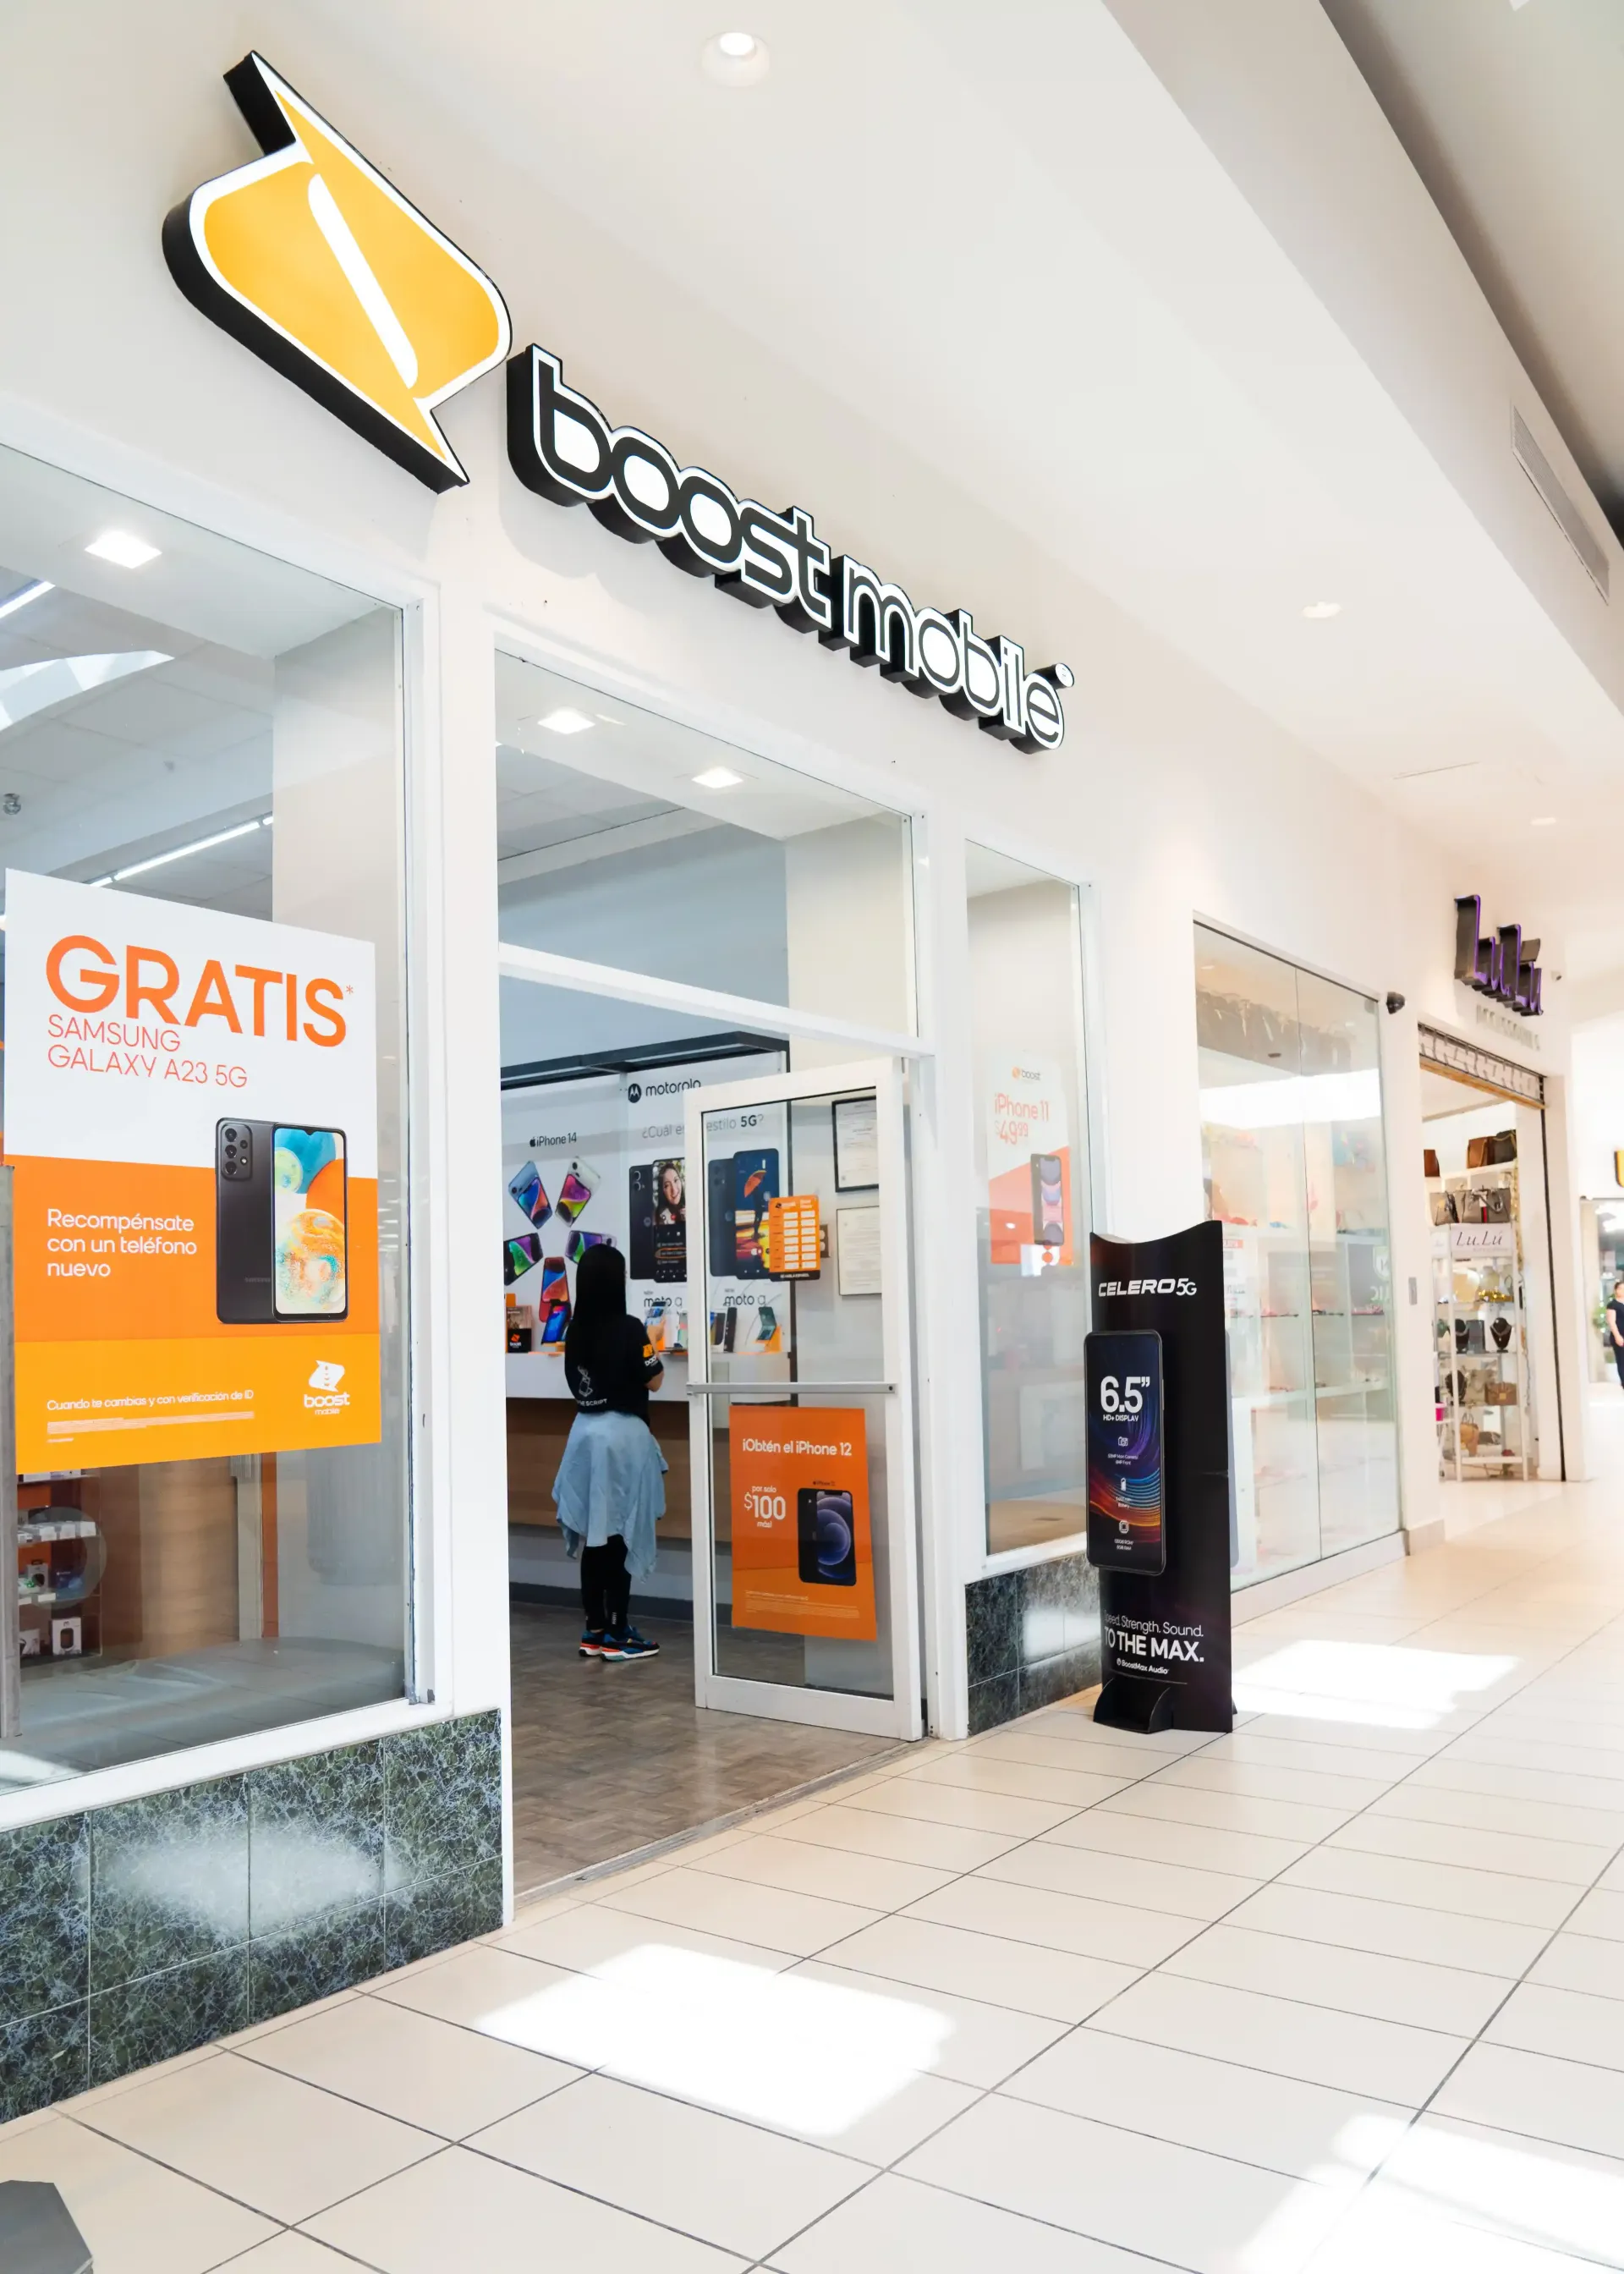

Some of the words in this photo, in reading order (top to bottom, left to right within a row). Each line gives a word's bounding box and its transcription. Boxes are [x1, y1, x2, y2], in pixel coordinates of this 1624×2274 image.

[529, 342, 833, 633] boost
[842, 553, 1065, 750] mobile
[47, 1013, 181, 1052] SAMSUNG
[47, 1044, 157, 1078] GALAXY
[164, 1058, 208, 1084] A23
[215, 1063, 248, 1088] 5G
[995, 1092, 1038, 1120] iPhone
[1040, 1099, 1050, 1122] 11
[642, 1124, 672, 1140] ¿Cuál
[706, 1118, 737, 1132] estilo
[740, 1113, 765, 1128] 5G?
[536, 1135, 567, 1147] iPhone
[568, 1131, 577, 1143] 14
[47, 1208, 195, 1234] Recompénsate
[47, 1238, 86, 1252] con
[91, 1239, 116, 1253] un
[119, 1235, 197, 1255] teléfono
[47, 1262, 112, 1277] nuevo
[724, 1294, 755, 1307] moto
[47, 1399, 90, 1410] Cuando
[92, 1399, 102, 1409] te
[104, 1396, 147, 1408] cambias
[149, 1398, 155, 1408] y
[156, 1395, 175, 1405] con
[177, 1392, 230, 1403] verificación
[229, 1391, 244, 1401] de
[244, 1390, 255, 1399] ID
[303, 1391, 351, 1409] boost
[1115, 1414, 1139, 1422] DISPLAY
[783, 1441, 794, 1453] el
[796, 1441, 837, 1456] iPhone
[839, 1442, 853, 1456] 12
[764, 1485, 777, 1493] solo
[743, 1491, 787, 1520] $100
[1121, 1614, 1161, 1635] Strength.
[1162, 1621, 1204, 1638] Sound.
[1116, 1630, 1147, 1656] THE
[1150, 1636, 1205, 1663] MAX.
